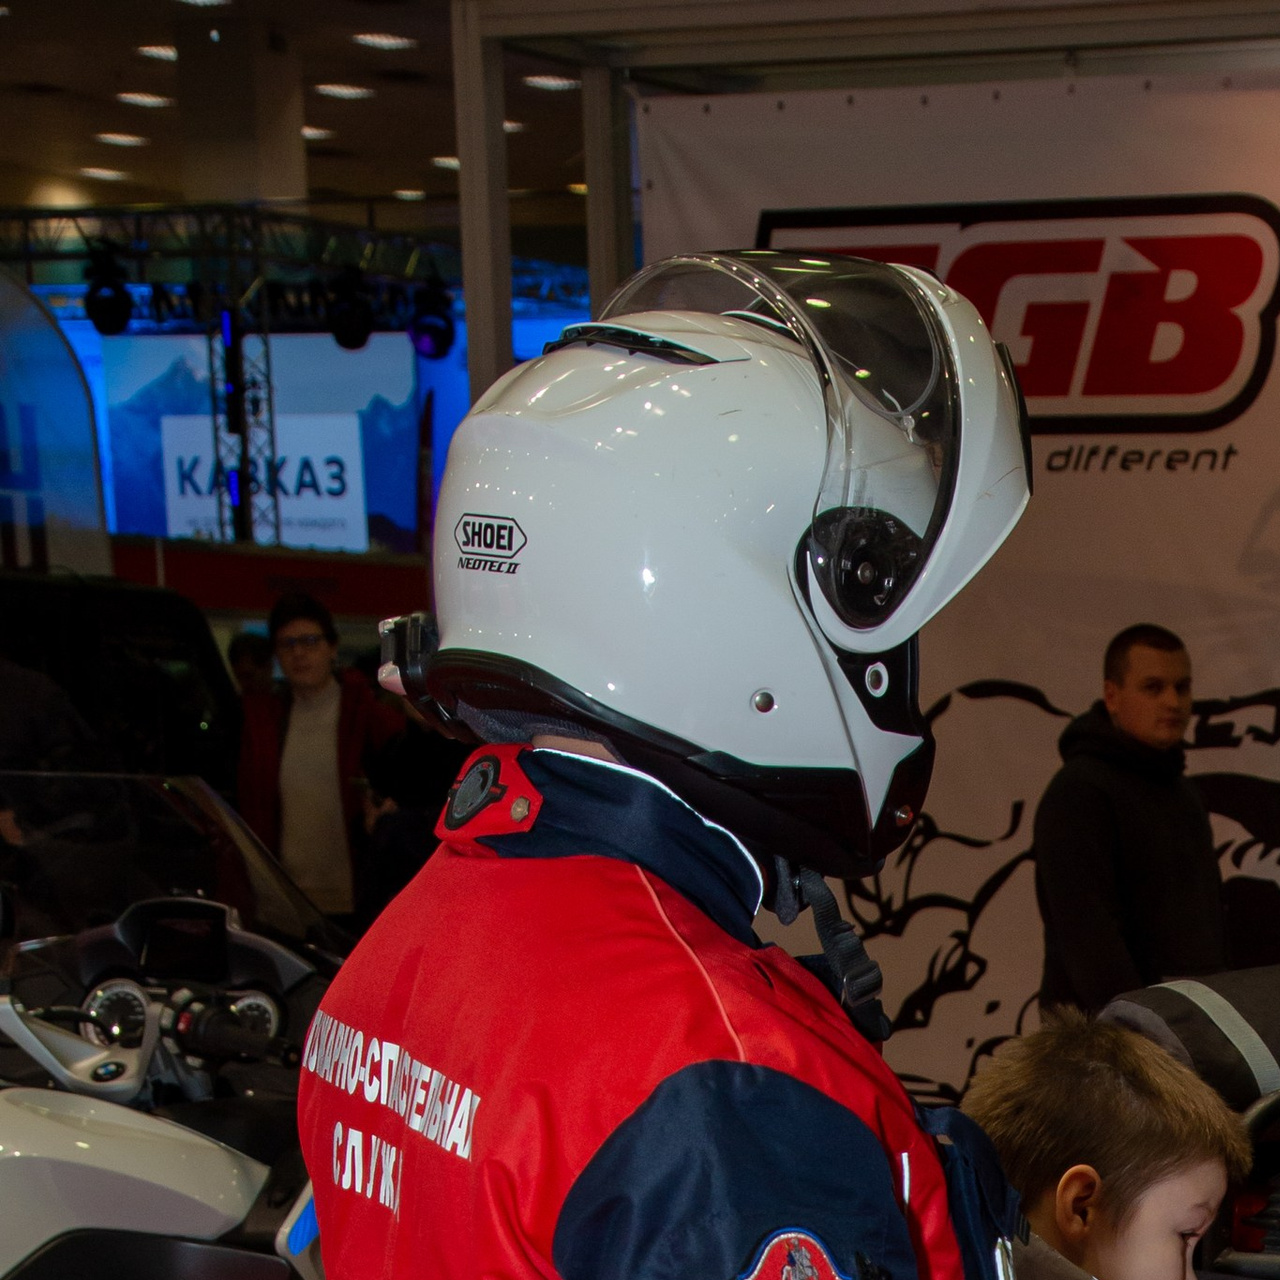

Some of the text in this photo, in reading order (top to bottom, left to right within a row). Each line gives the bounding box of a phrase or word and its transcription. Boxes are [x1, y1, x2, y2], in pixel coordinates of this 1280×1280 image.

[803, 233, 1263, 397] GB
[1046, 443, 1238, 472] different
[462, 520, 514, 551] SHOEI
[457, 556, 508, 573] NEOTEC
